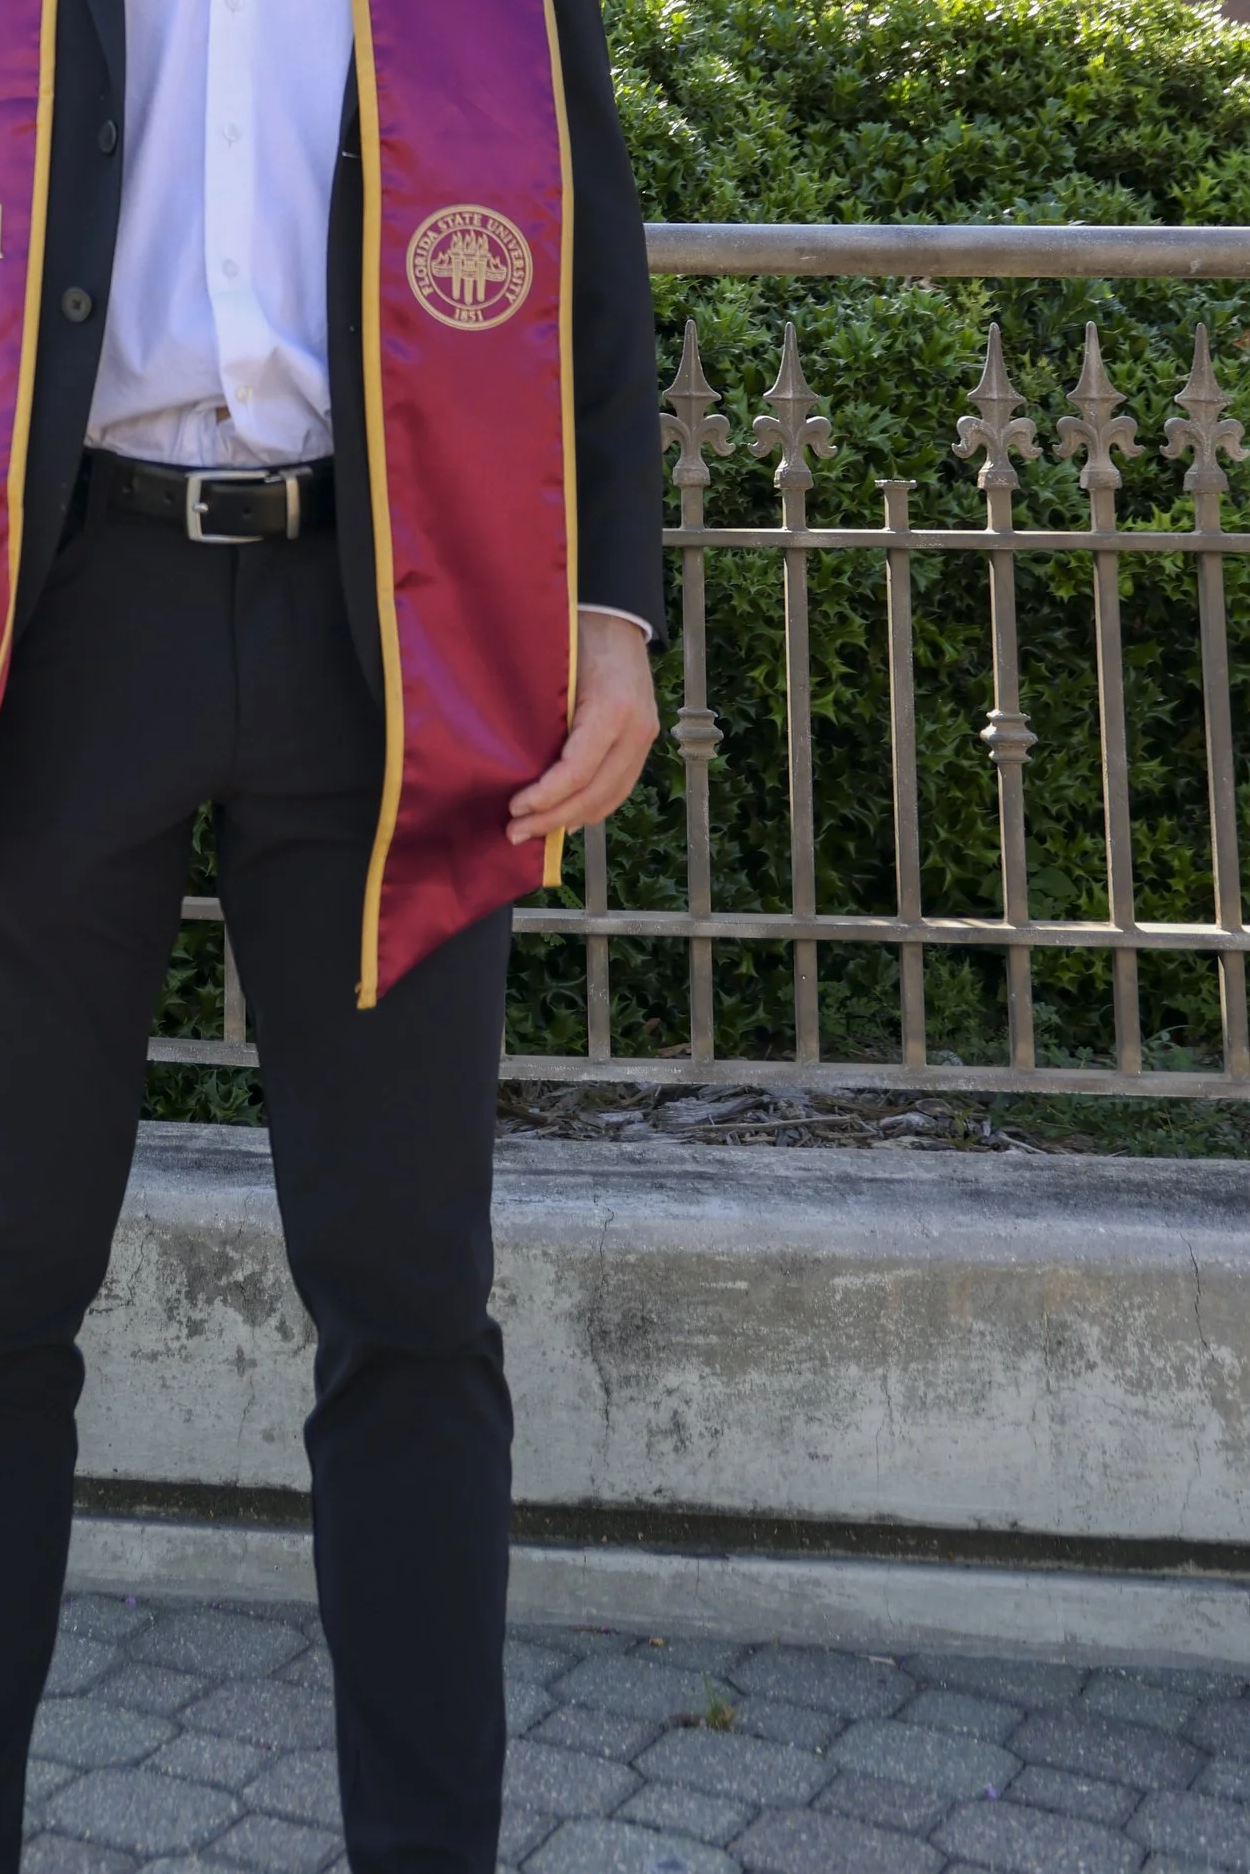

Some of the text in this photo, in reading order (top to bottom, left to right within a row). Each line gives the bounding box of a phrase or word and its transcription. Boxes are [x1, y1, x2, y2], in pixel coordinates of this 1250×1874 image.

[413, 213, 525, 304] FLORIDA STATE UNIVERSITY
[454, 308, 484, 322] 1851
